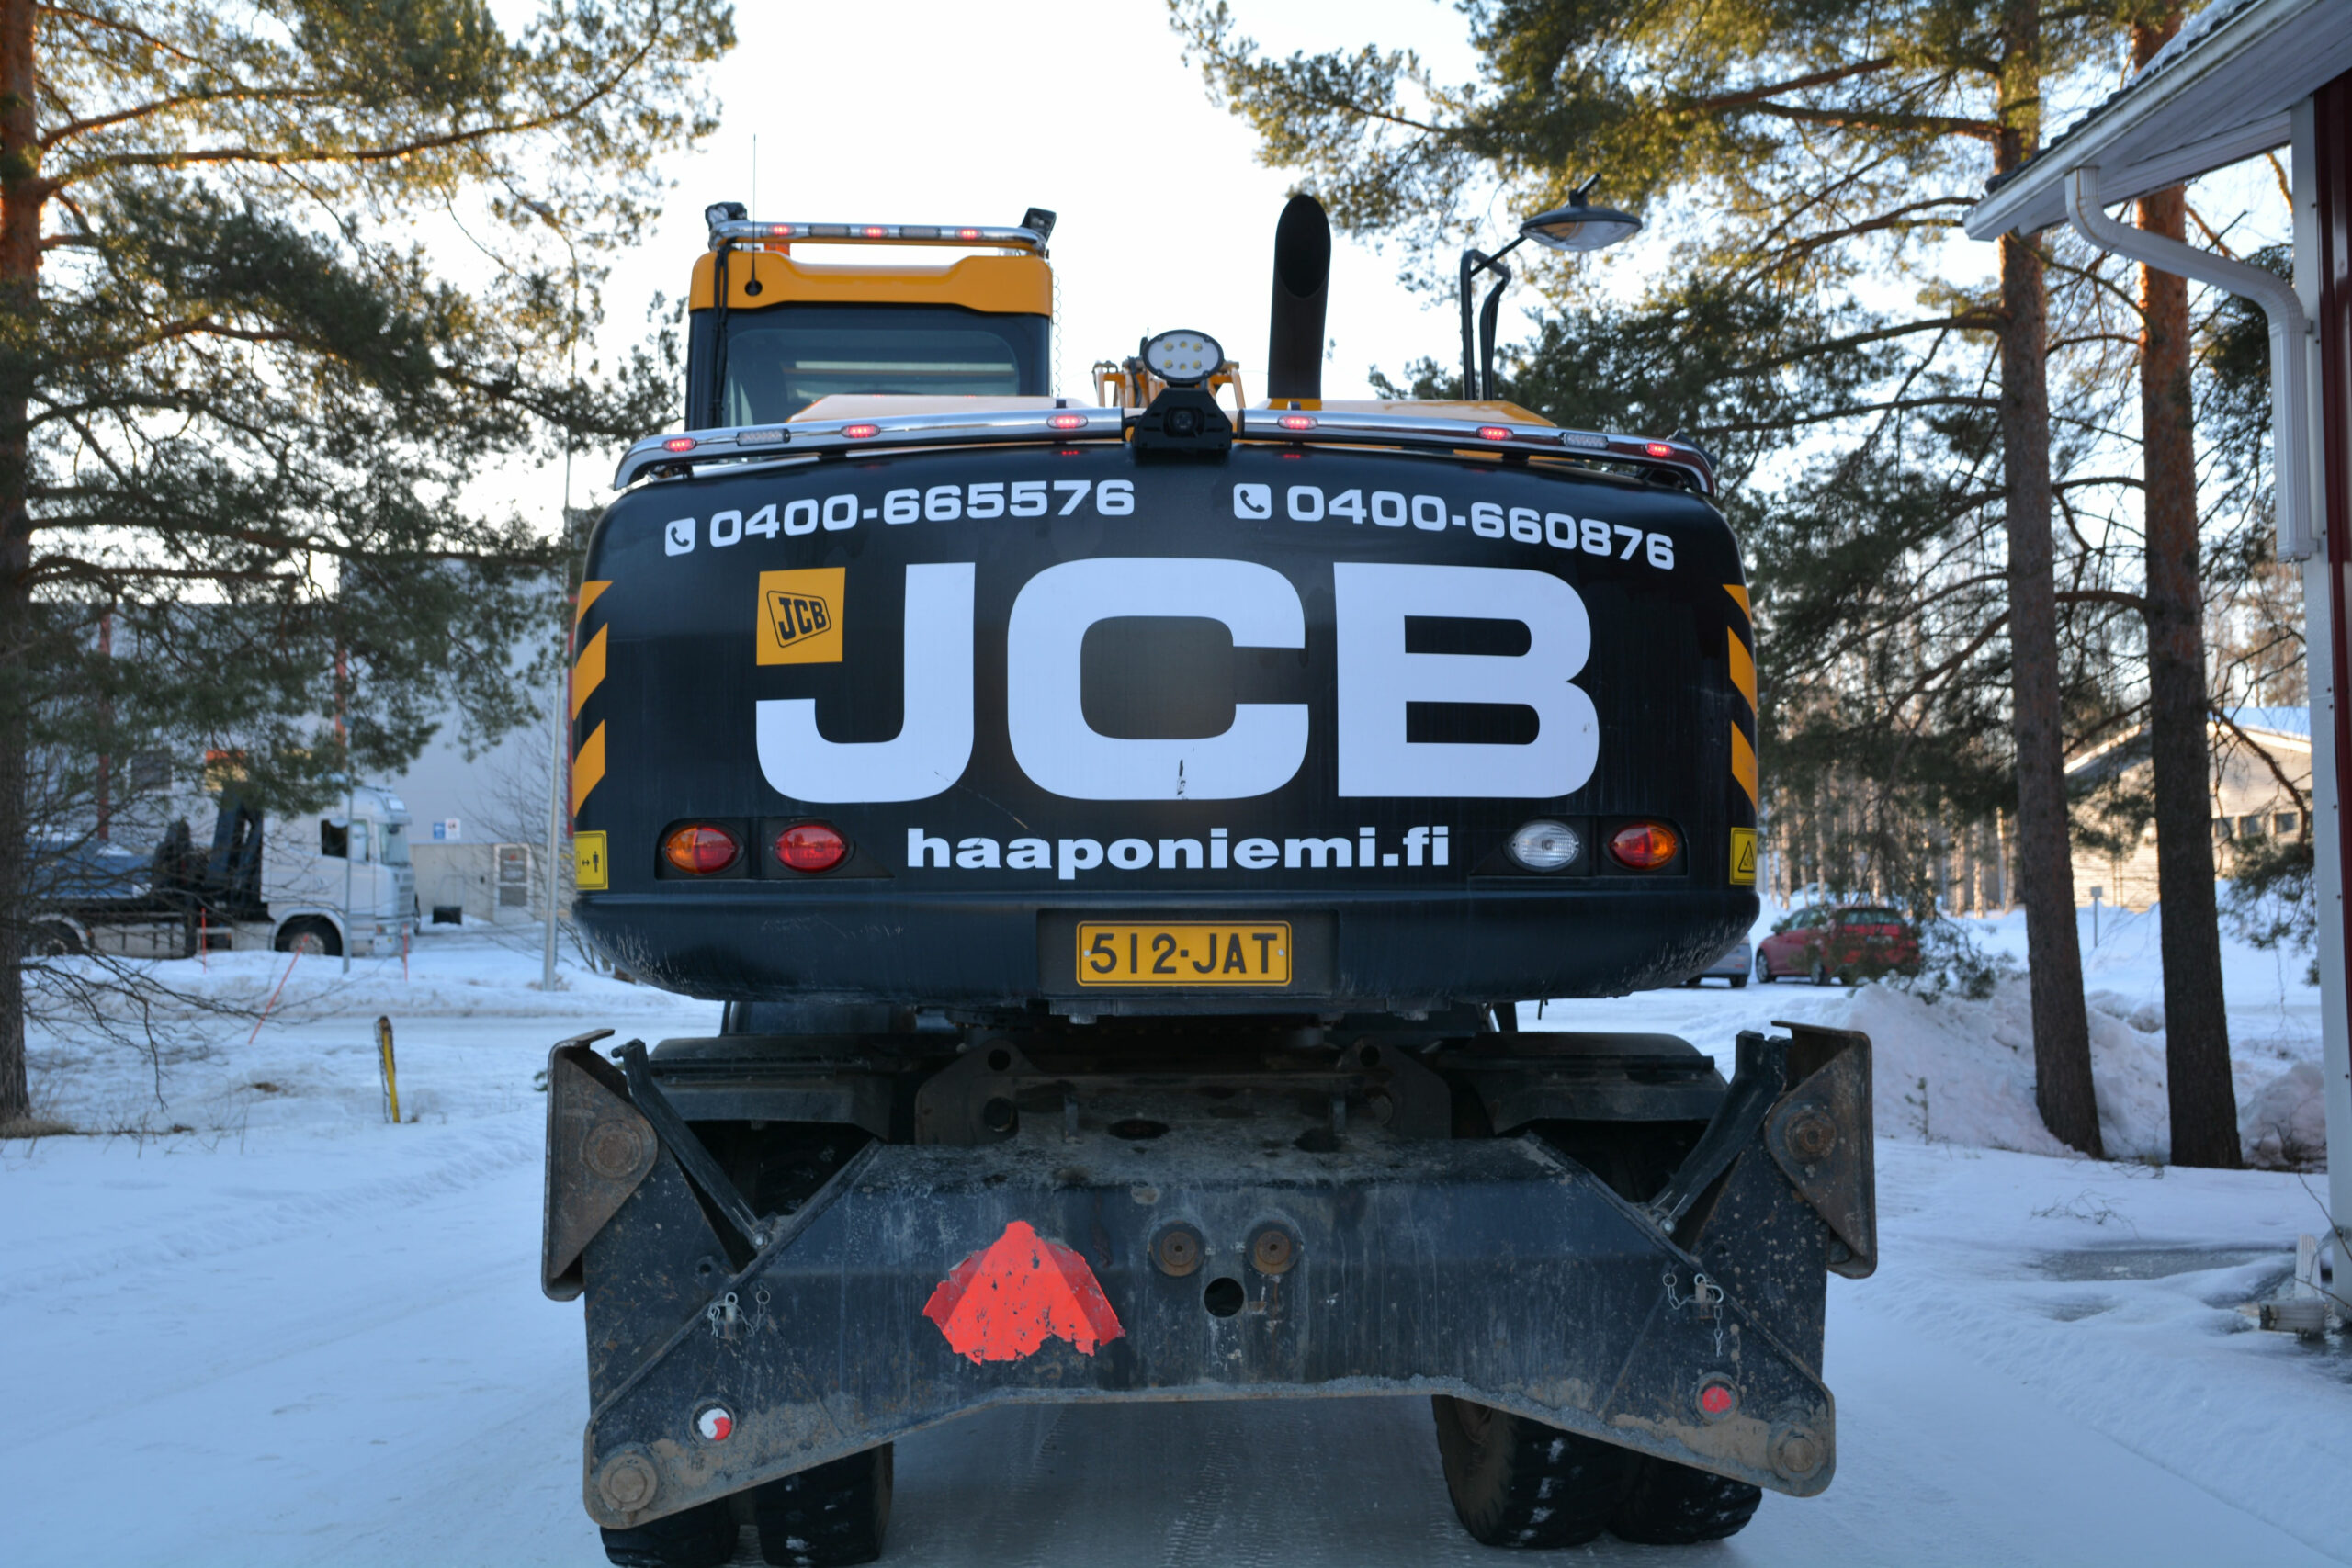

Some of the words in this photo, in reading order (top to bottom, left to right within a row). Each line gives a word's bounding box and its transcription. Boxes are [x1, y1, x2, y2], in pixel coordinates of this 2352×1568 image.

[709, 480, 1135, 547] 0400-665576
[1287, 486, 1674, 570] 0400-660876
[778, 597, 827, 640] JCB
[756, 558, 1600, 803] JCB
[908, 827, 1449, 879] haaponiemi.fi
[1091, 933, 1278, 974] 512-JAT
